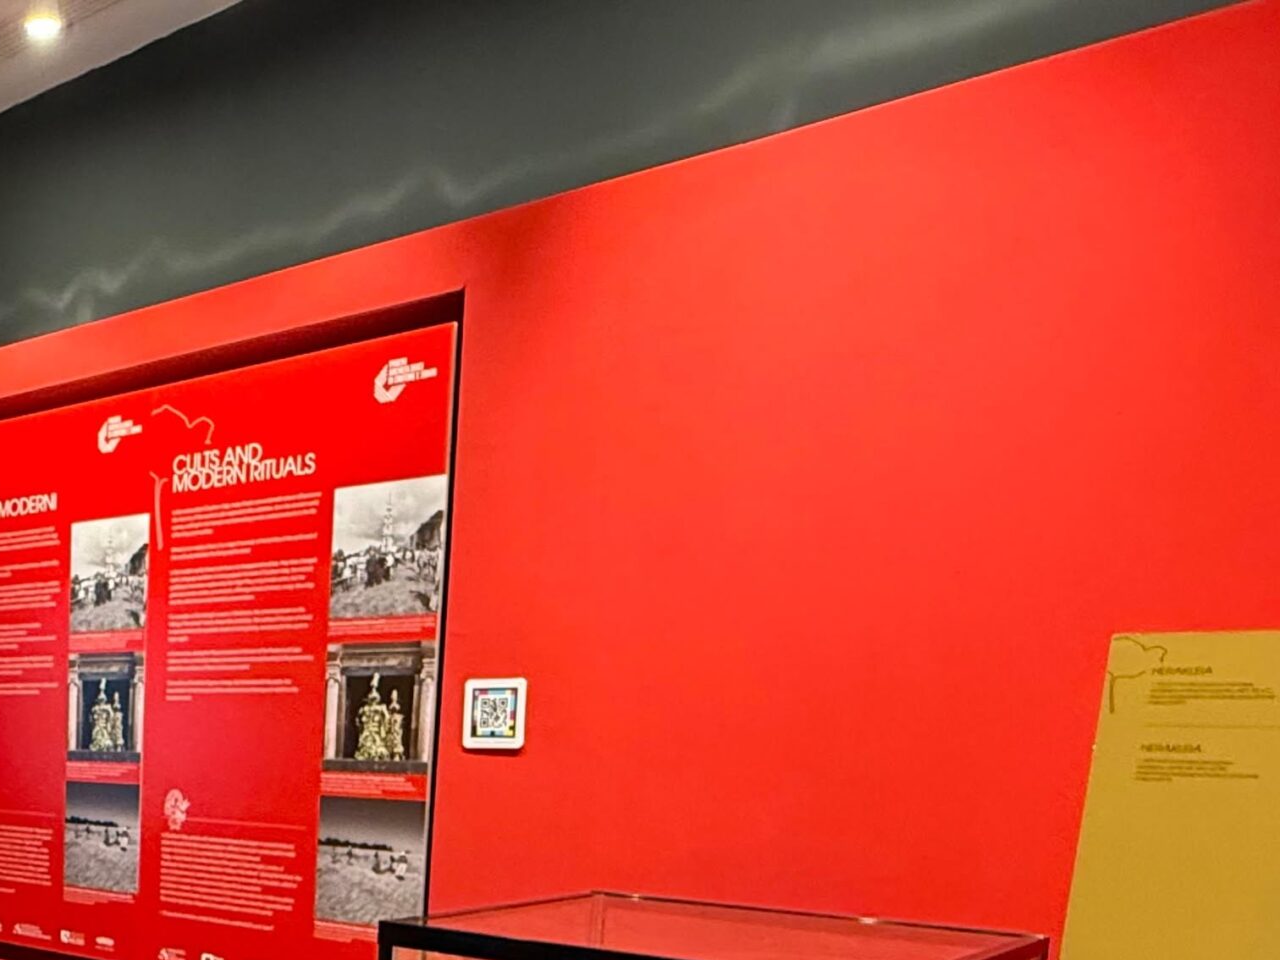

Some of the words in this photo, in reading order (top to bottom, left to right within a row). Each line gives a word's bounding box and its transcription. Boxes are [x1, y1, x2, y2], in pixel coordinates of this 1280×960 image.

[172, 449, 220, 475] CULTS
[223, 443, 263, 465] AND
[172, 465, 247, 493] MODERN
[250, 452, 316, 482] RITUALS
